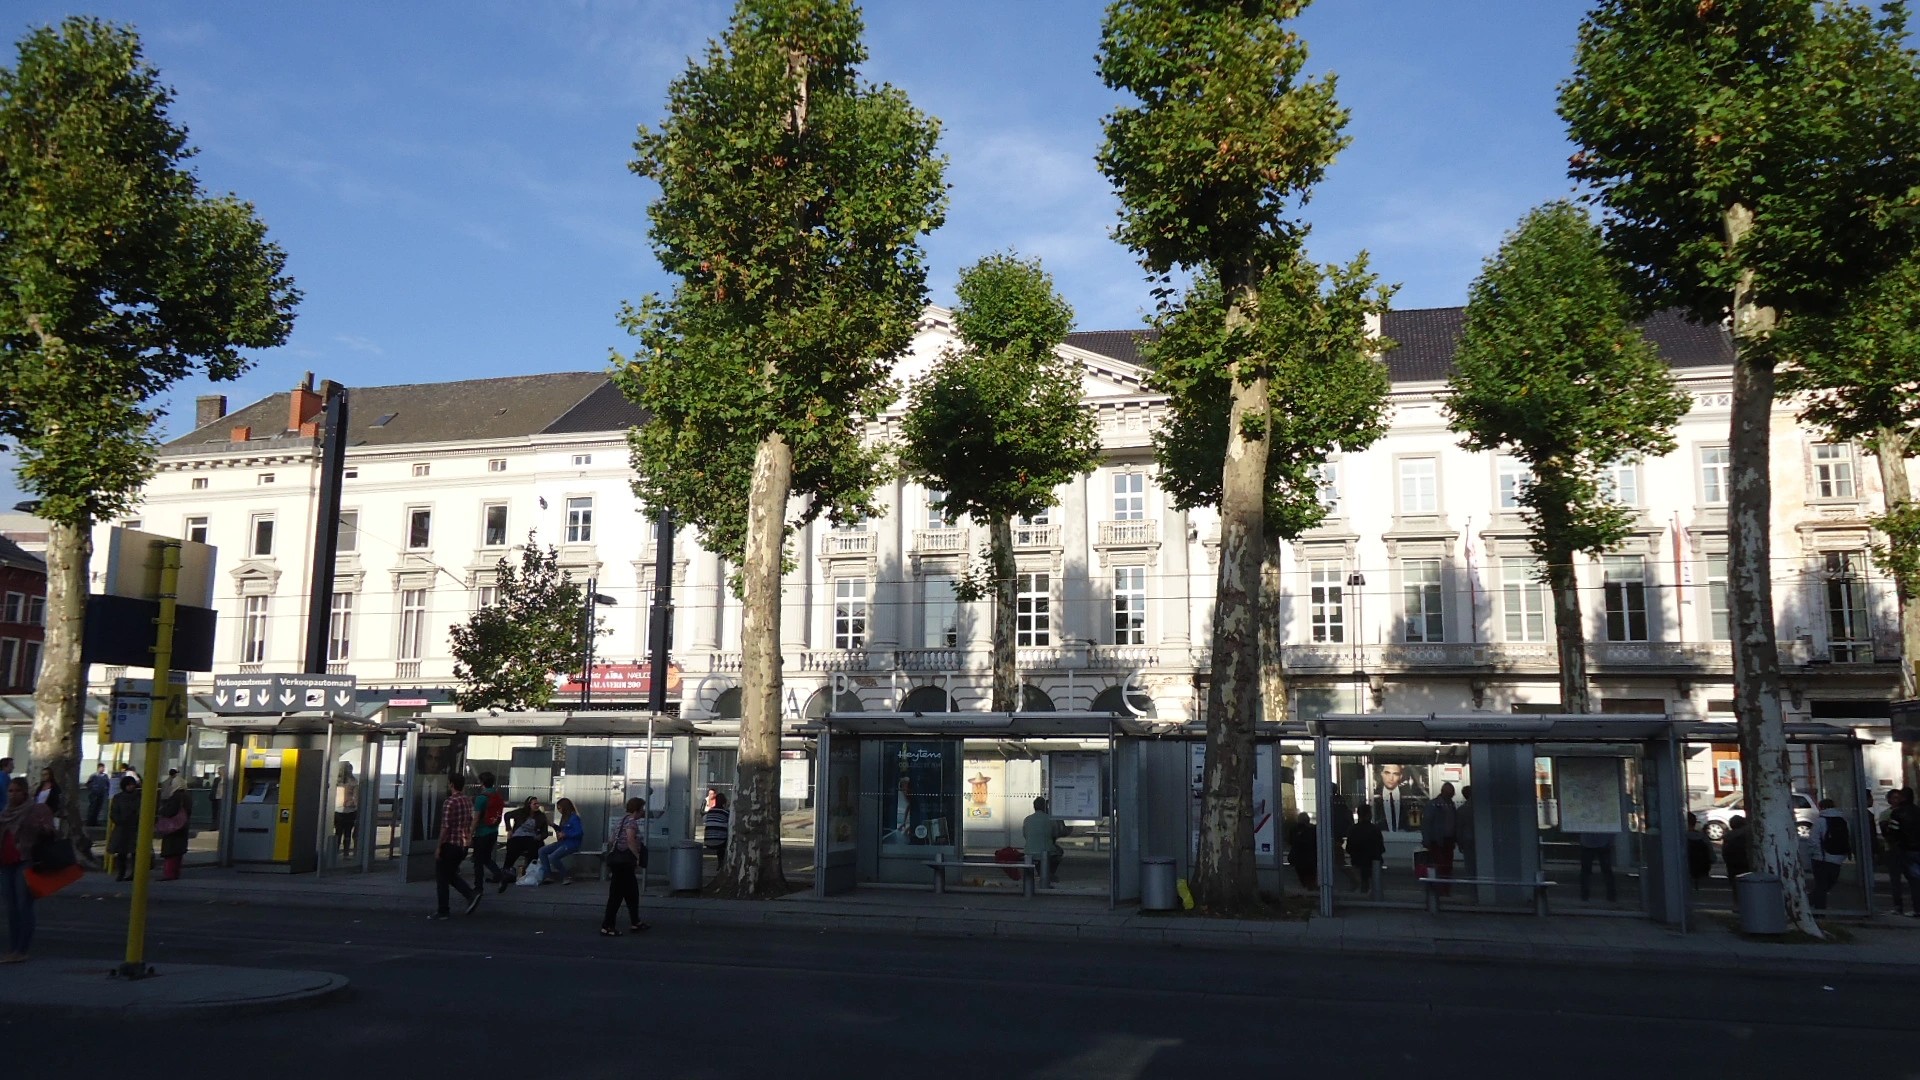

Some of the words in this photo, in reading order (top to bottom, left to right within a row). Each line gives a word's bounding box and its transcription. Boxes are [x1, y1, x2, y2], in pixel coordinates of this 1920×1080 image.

[216, 678, 272, 687] Verkoopautomaat
[280, 678, 352, 687] Verkoopautomaat
[696, 668, 1151, 718] CAPITLE
[165, 694, 184, 725] 4
[897, 749, 942, 762] Heytens
